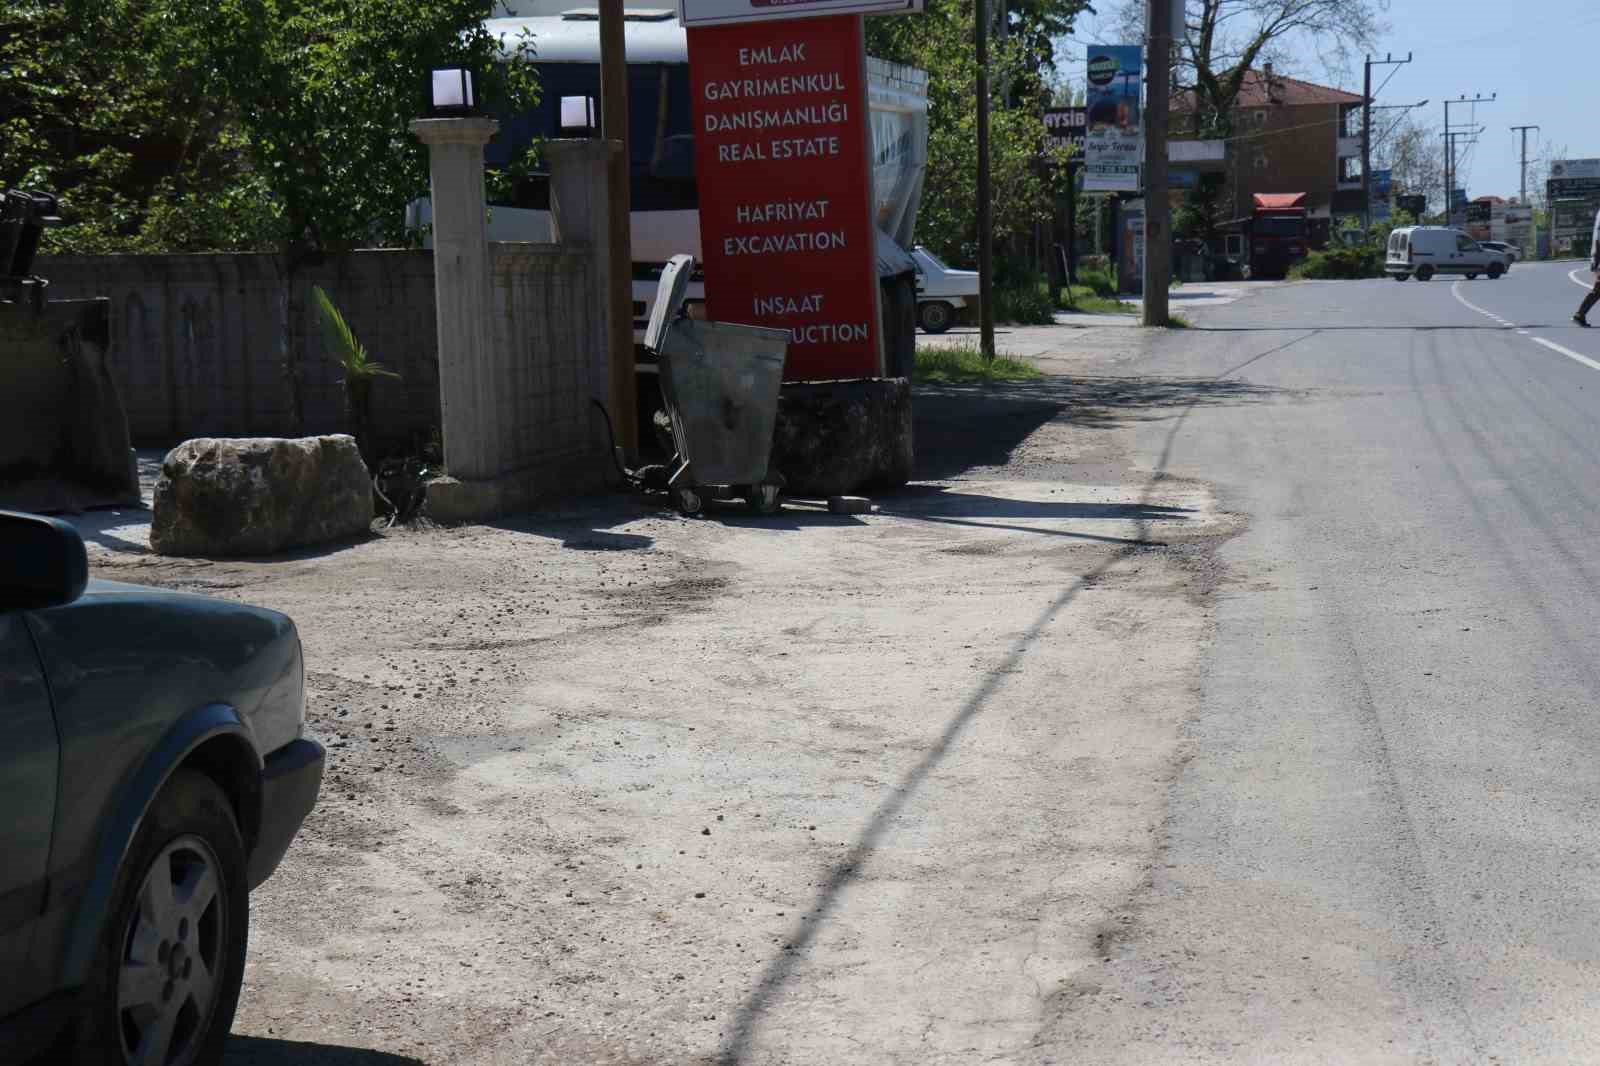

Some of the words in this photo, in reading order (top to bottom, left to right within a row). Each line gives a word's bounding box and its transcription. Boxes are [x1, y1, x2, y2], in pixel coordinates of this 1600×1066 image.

[738, 43, 806, 66] EMLAK
[704, 72, 845, 100] GAYRİMENKUL
[718, 143, 766, 163] REAL
[771, 137, 839, 159] ESTATE
[736, 198, 829, 223] HAFRİYAT
[723, 231, 846, 256] EXCAVATION
[792, 323, 868, 344] UCTION
